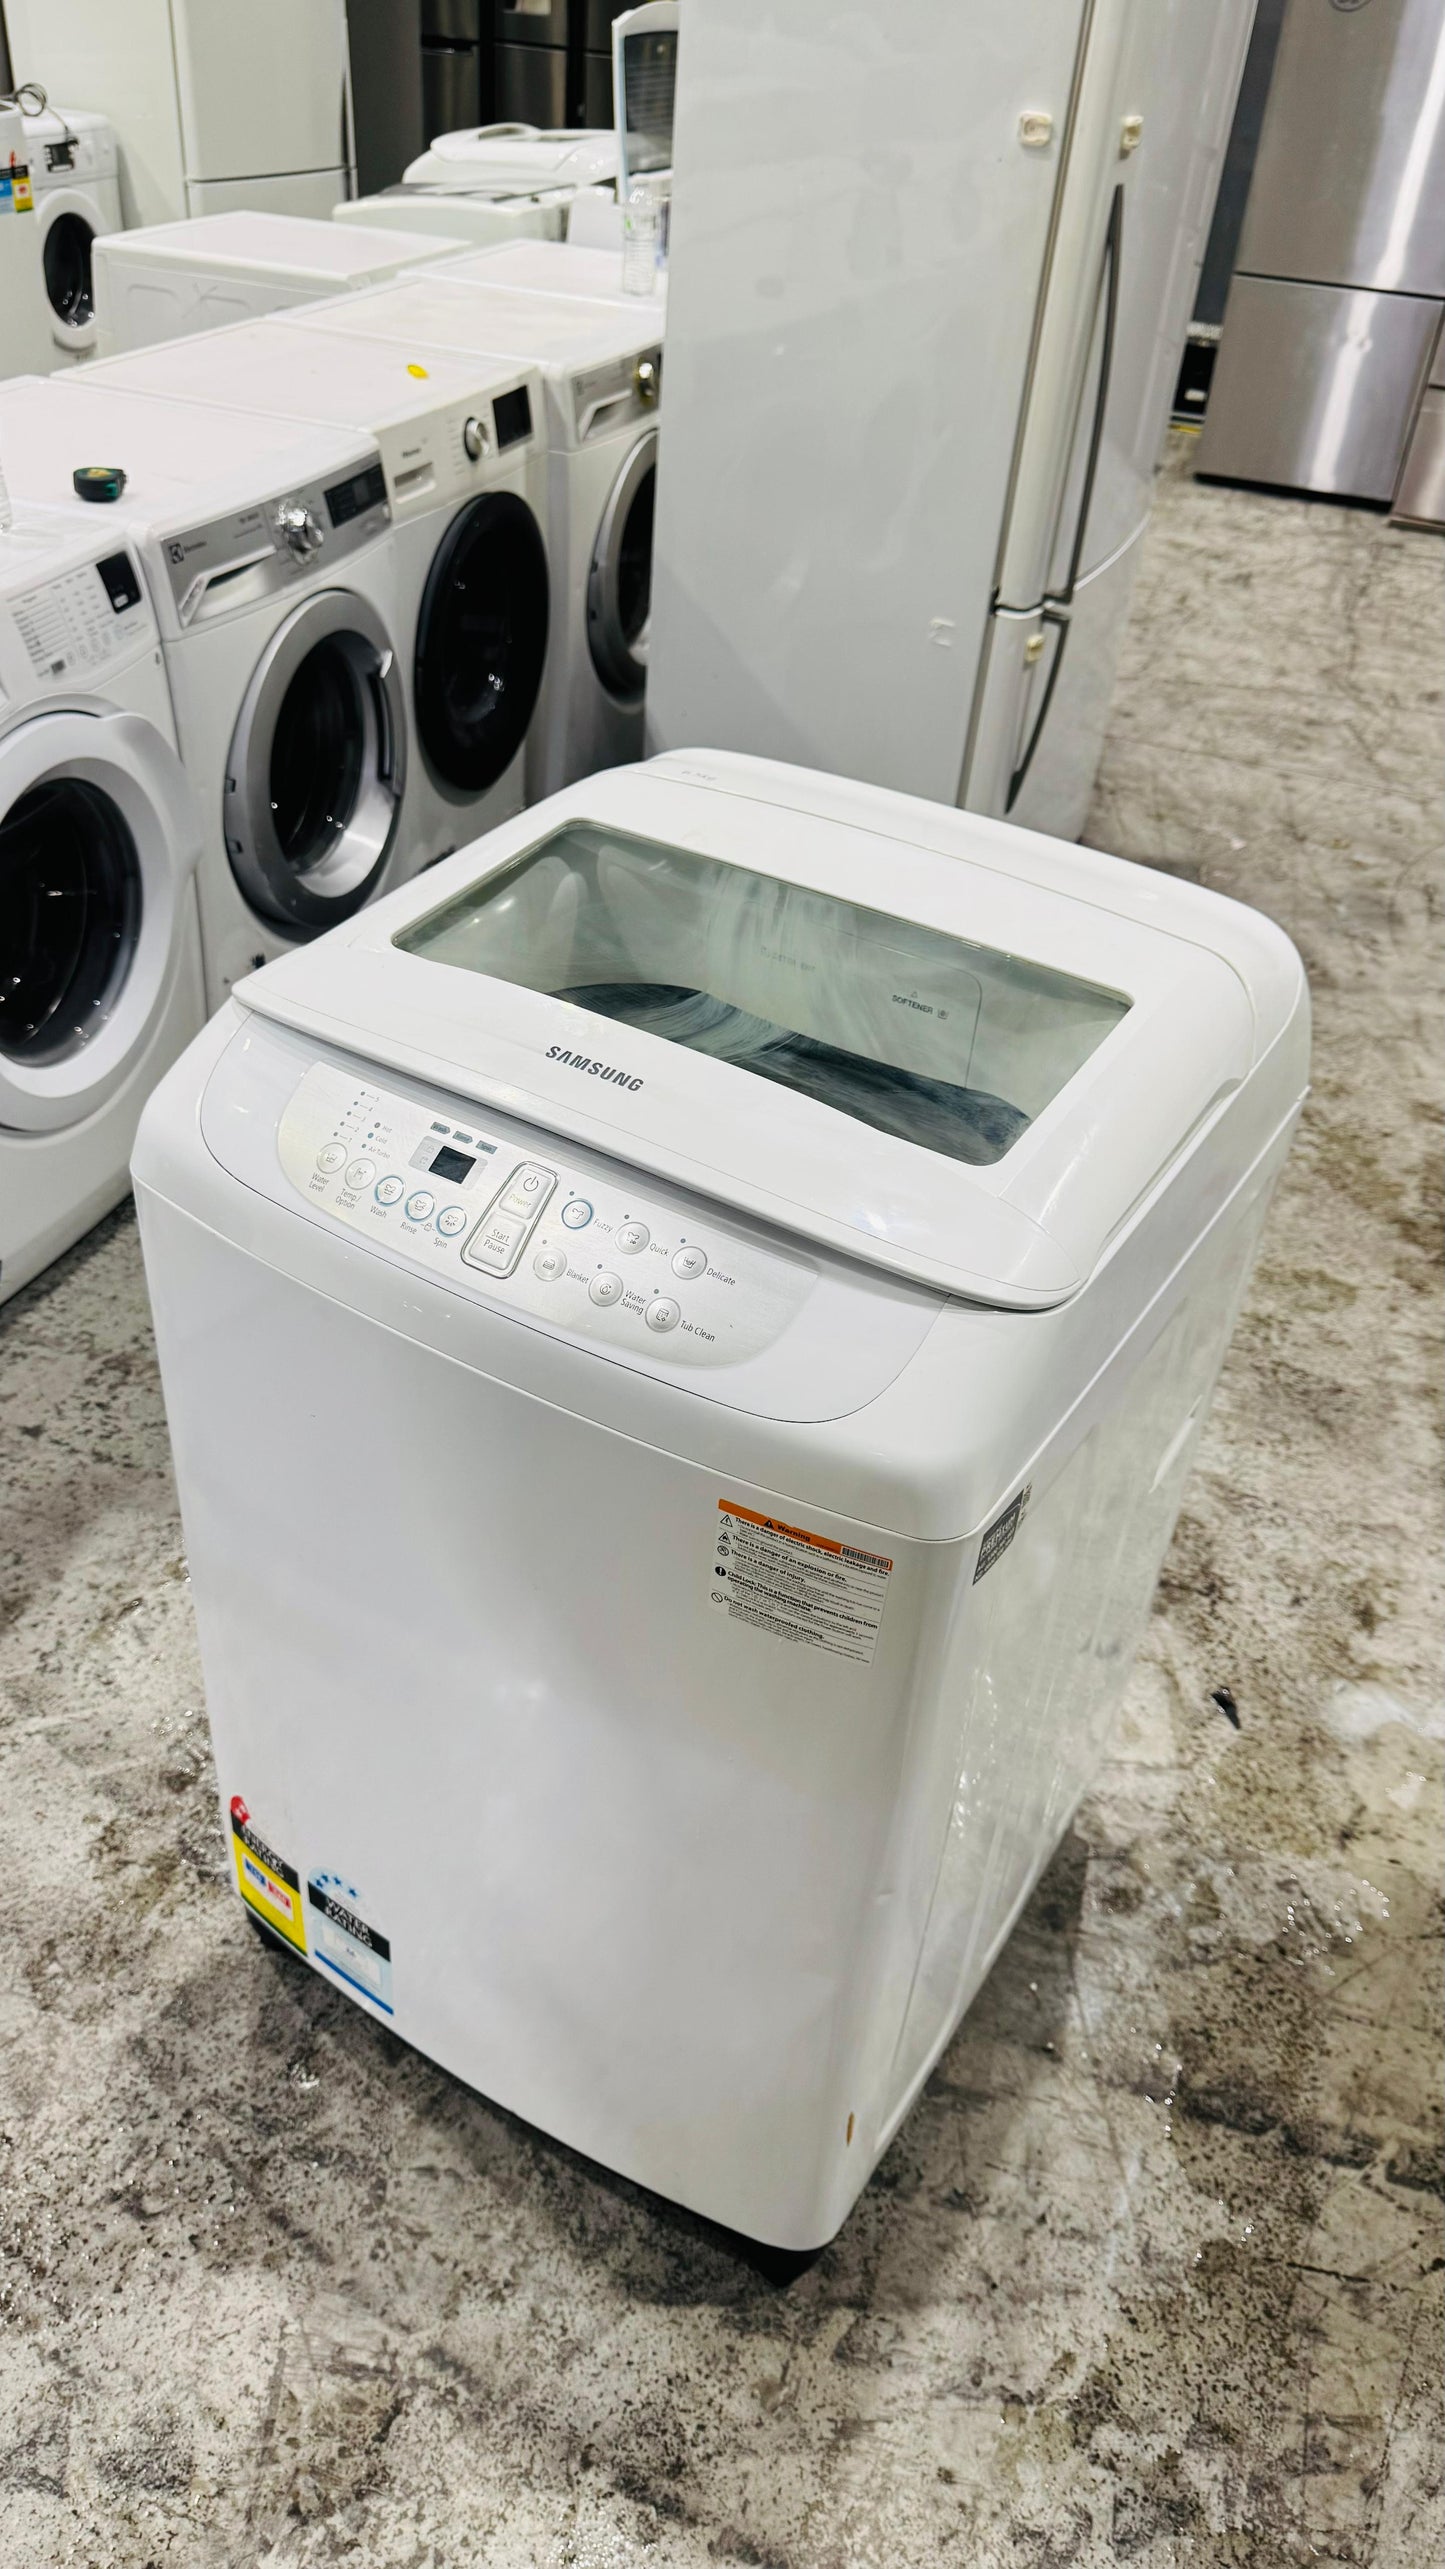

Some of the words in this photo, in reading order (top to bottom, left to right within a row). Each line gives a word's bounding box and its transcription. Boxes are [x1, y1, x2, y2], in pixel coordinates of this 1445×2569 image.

[892, 994, 933, 1014] SOFTENER
[545, 1046, 644, 1091] SAMSUNG
[375, 1135, 388, 1144] Cold
[311, 1172, 330, 1185] Water
[308, 1181, 326, 1193] Level
[341, 1188, 362, 1202] Temp/
[335, 1196, 356, 1210] Option
[510, 1193, 532, 1209] Power
[370, 1206, 388, 1218] Wash
[400, 1222, 418, 1235] Rinse
[593, 1218, 614, 1233] Fuzzy
[433, 1237, 448, 1249] Spin
[491, 1228, 511, 1243] Start
[483, 1240, 505, 1255] Pause
[649, 1242, 669, 1257] Quick
[566, 1270, 590, 1284] Blanket
[706, 1268, 736, 1286] Delicate
[625, 1290, 647, 1305] Water
[620, 1298, 644, 1316] Saving
[681, 1320, 693, 1332] Tub
[694, 1326, 715, 1342] Clean
[777, 1524, 810, 1542] Warning
[735, 1517, 749, 1526] There
[759, 1526, 778, 1538] danger
[785, 1537, 805, 1548] electric
[823, 1550, 843, 1561] electric
[844, 1557, 865, 1570] leakage
[866, 1565, 877, 1573] and
[730, 1549, 746, 1559] There
[757, 1560, 778, 1573] danger
[786, 1571, 805, 1583] injury.
[732, 1535, 748, 1544] There
[759, 1545, 780, 1558] danger
[797, 1560, 826, 1575] explosion
[834, 1573, 847, 1581] fire.
[727, 1576, 753, 1590] operating
[763, 1590, 786, 1603] washing
[727, 1570, 741, 1579] Child
[757, 1582, 768, 1590] This
[778, 1590, 800, 1603] function
[801, 1599, 813, 1607] that
[813, 1604, 838, 1617] prevents
[839, 1612, 862, 1624] children
[863, 1620, 877, 1629] from
[732, 1599, 742, 1607] not
[743, 1604, 758, 1613] wash
[758, 1610, 797, 1628] waterproofed
[798, 1626, 824, 1639] clothing.
[327, 1898, 369, 1936] WATER
[325, 1907, 373, 1947] RATING
